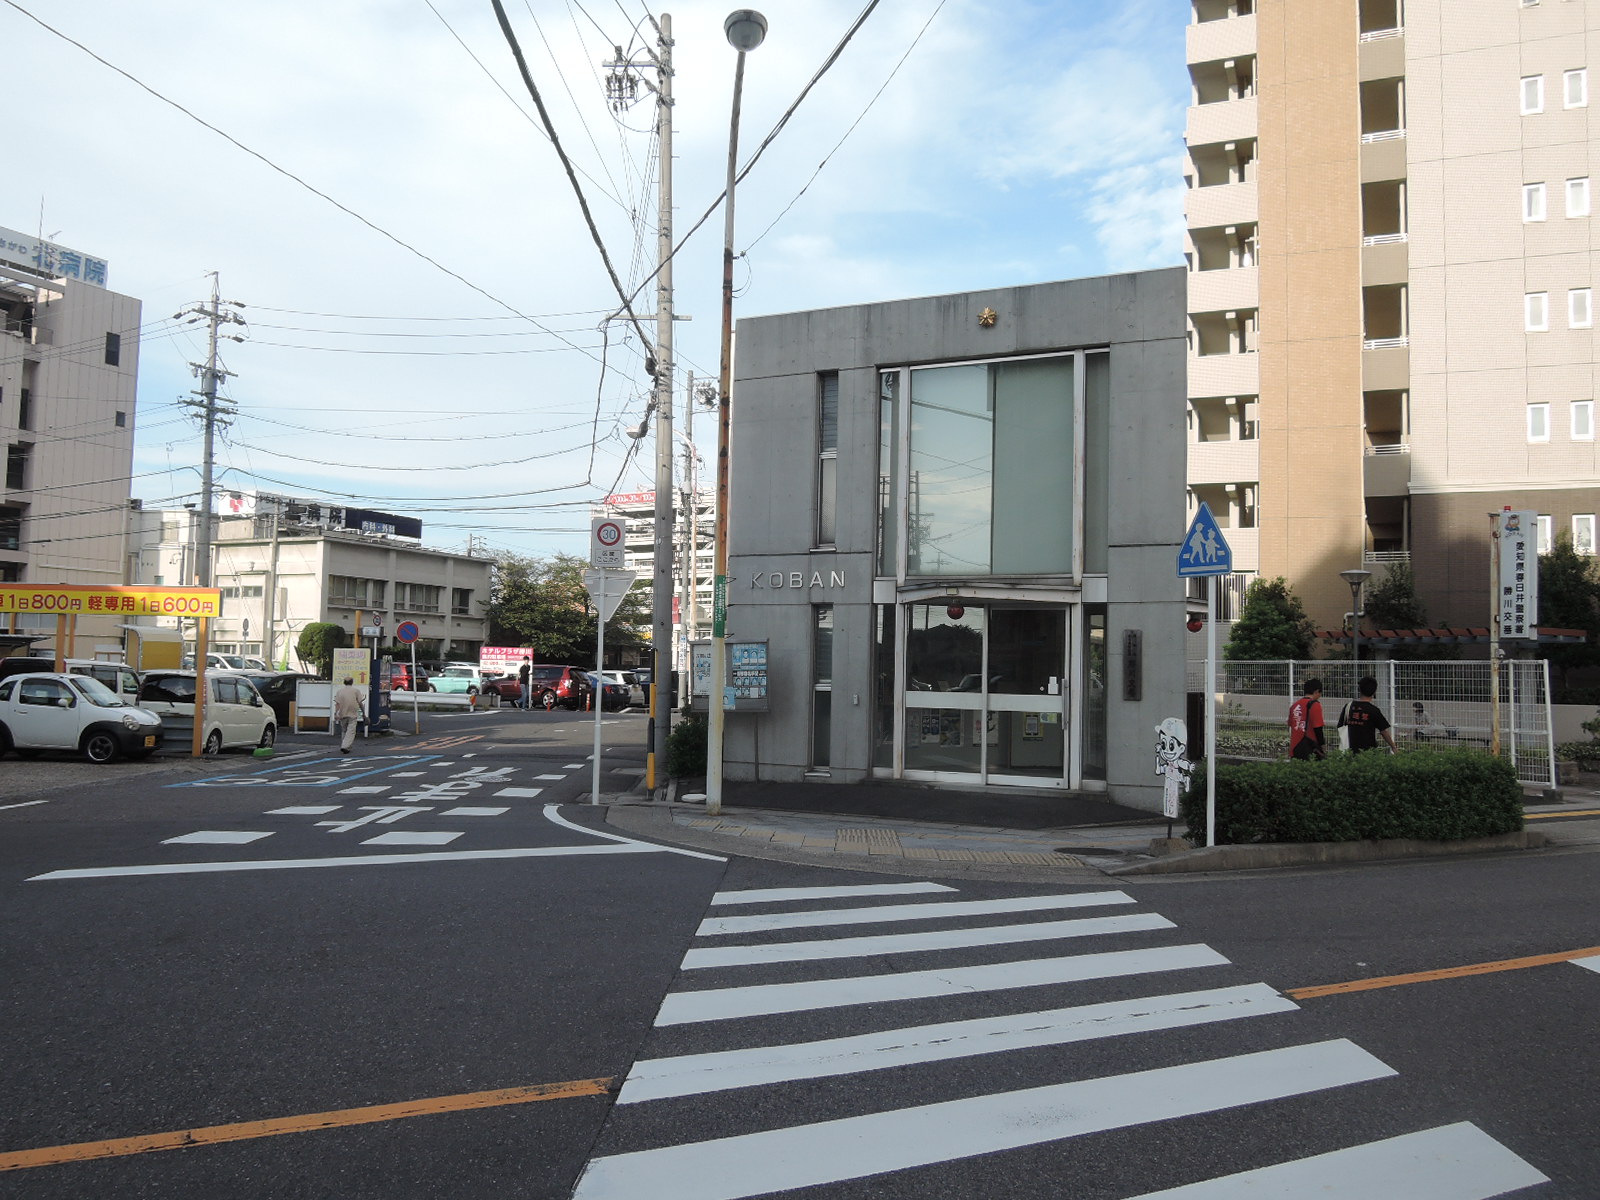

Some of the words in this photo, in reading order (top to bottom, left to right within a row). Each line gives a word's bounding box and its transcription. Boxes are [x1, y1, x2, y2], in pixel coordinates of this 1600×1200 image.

[361, 521, 395, 534] 内科・外科
[602, 529, 616, 540] 30
[751, 570, 847, 589] KOBAN
[1515, 541, 1526, 634] 愛知県春日井警察署
[0, 593, 82, 611] 1日800円
[1503, 586, 1513, 634] 勝川交番
